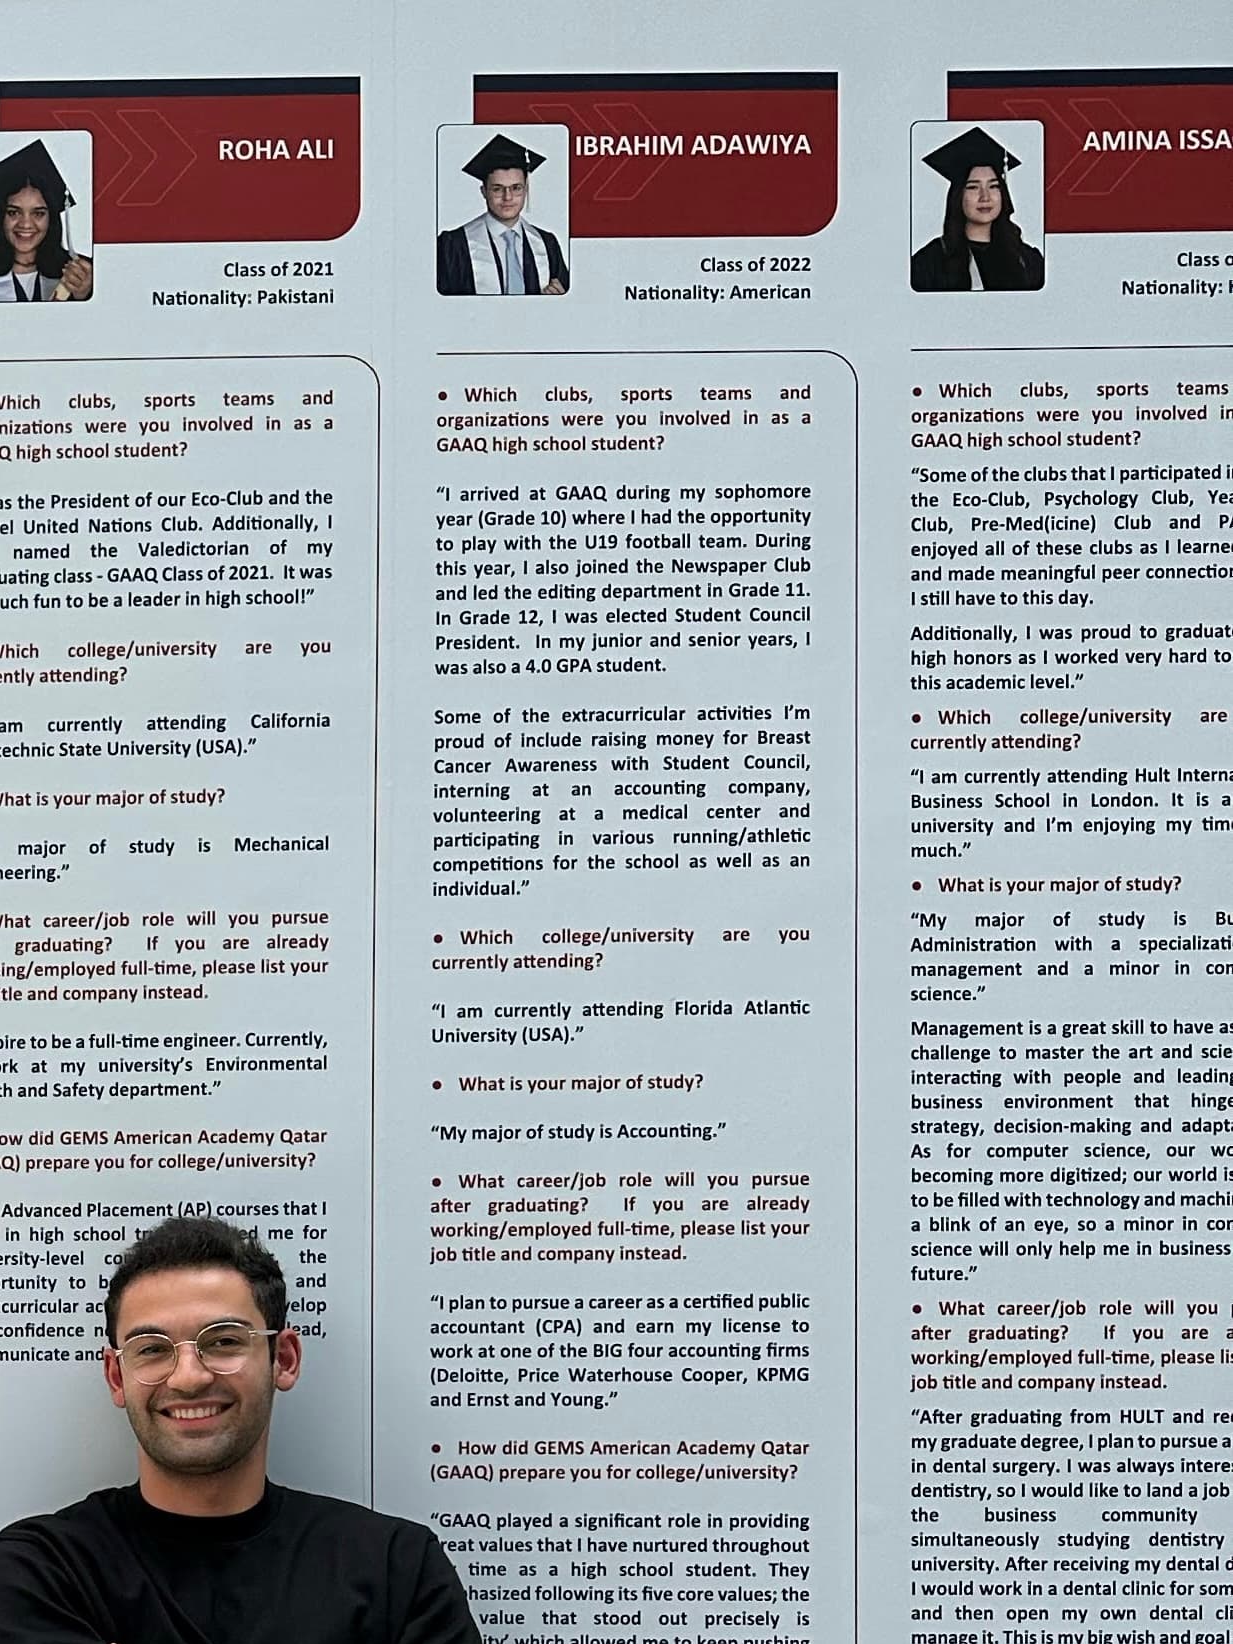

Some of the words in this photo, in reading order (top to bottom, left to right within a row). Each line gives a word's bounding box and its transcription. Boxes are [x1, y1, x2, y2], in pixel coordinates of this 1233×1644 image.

[576, 136, 683, 155] IBRAHIM
[691, 135, 811, 155] ADAWIYA
[1083, 130, 1172, 151] AMINA
[1180, 129, 1232, 149] ISSA
[220, 140, 290, 160] ROHA
[297, 139, 333, 159] ALI
[701, 257, 747, 272] Class
[748, 257, 765, 272] of
[770, 257, 811, 271] 2022
[1177, 252, 1219, 267] Class
[224, 262, 265, 277] Class
[271, 261, 289, 276] of
[293, 262, 334, 276] 2021
[625, 285, 724, 303] Nationality:
[730, 284, 810, 299] American
[1122, 279, 1222, 297] Nationality:
[153, 290, 251, 308] Nationality:
[258, 289, 333, 304] Pakistani
[24, 518, 78, 534] United
[89, 518, 152, 533] Nations
[161, 516, 202, 531] Club.
[212, 514, 318, 533] Additionally,
[328, 515, 332, 529] I
[436, 515, 473, 530] year
[479, 510, 535, 529] (Grade
[541, 510, 566, 528] 10)
[572, 510, 625, 525] where
[631, 510, 635, 524] I
[641, 509, 671, 524] had
[677, 509, 705, 524] the
[711, 508, 811, 527] opportunity
[911, 675, 941, 690] this
[946, 674, 1025, 689] academic
[59, 742, 102, 756] State
[108, 740, 191, 758] University
[434, 760, 491, 773] Cancer
[505, 758, 597, 772] Awareness
[611, 756, 648, 771] with
[663, 755, 729, 770] Student
[744, 754, 810, 771] Council,
[18, 1082, 47, 1097] and
[53, 1082, 104, 1100] Safety
[26, 1158, 89, 1173] prepare
[94, 1158, 124, 1172] you
[130, 1154, 153, 1168] for
[158, 1152, 315, 1171] college/university?
[431, 1368, 508, 1385] (Deloitte,
[518, 1368, 559, 1382] Price
[568, 1367, 672, 1382] Waterhouse
[682, 1368, 747, 1385] Cooper,
[758, 1367, 809, 1381] KPMG
[910, 1374, 937, 1392] job
[942, 1374, 976, 1389] title
[982, 1374, 1012, 1389] and
[1018, 1378, 1095, 1392] company
[1100, 1374, 1167, 1389] instead.
